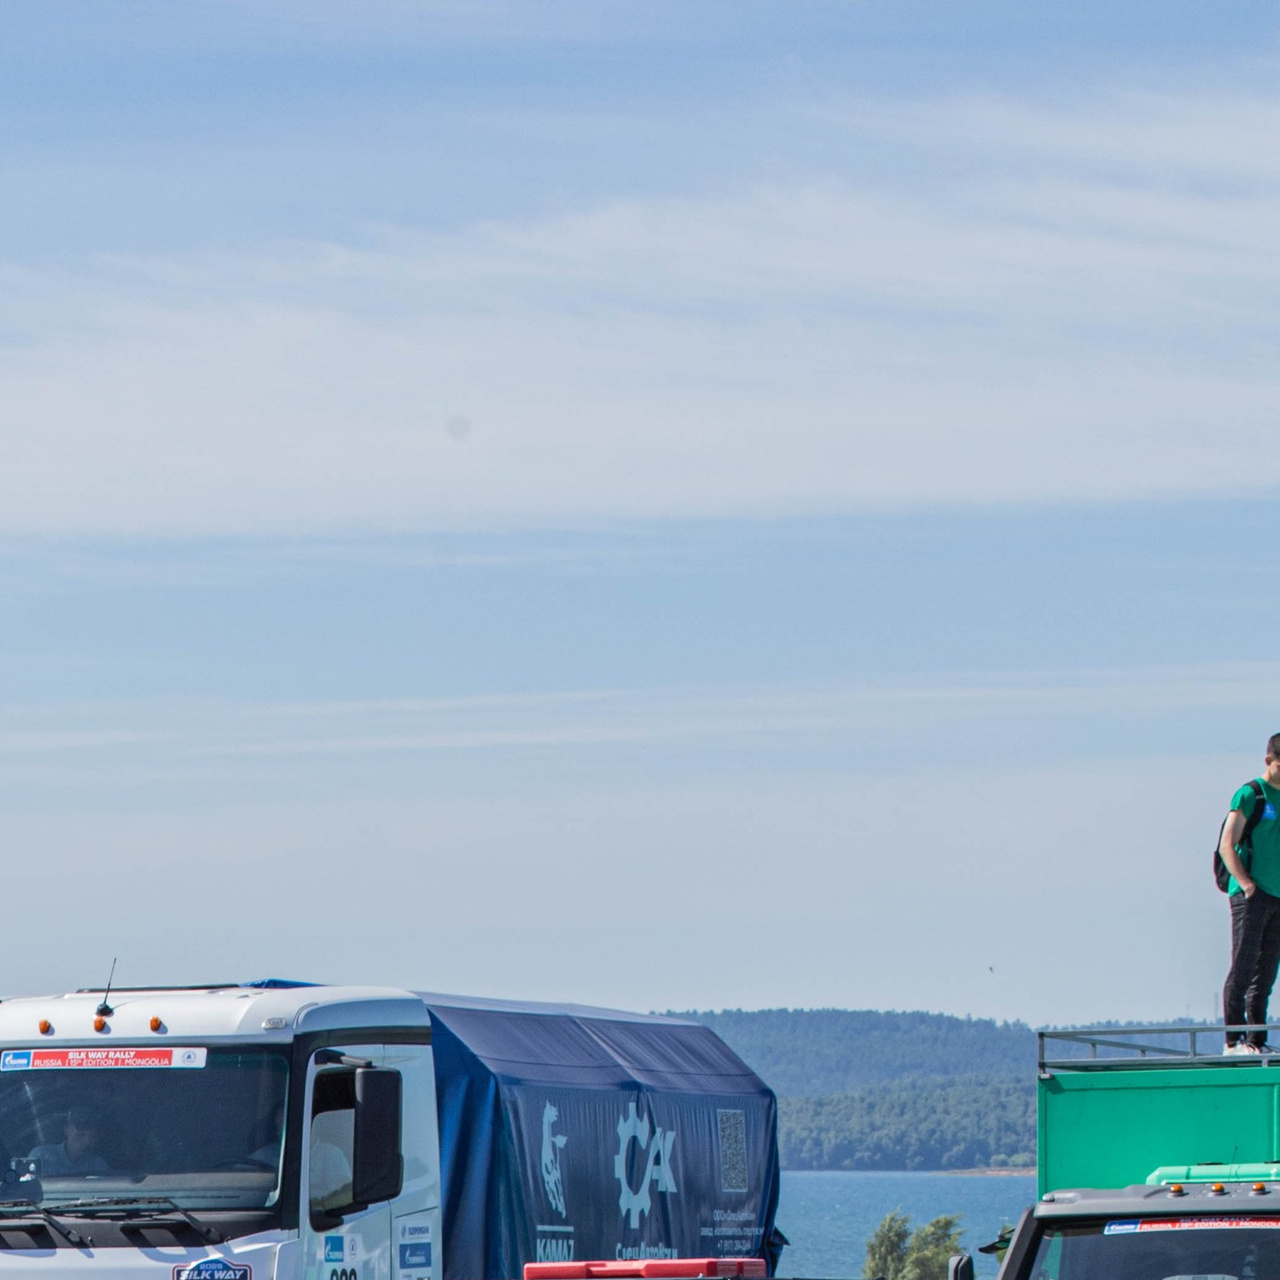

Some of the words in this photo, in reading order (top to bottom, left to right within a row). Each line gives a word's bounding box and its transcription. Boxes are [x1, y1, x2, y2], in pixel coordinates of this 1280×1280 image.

[68, 1051, 86, 1059] SILK
[88, 1051, 107, 1059] WAY
[108, 1051, 135, 1059] RALLY
[34, 1059, 62, 1067] RUSSIA
[82, 1058, 115, 1066] EDITION
[124, 1058, 169, 1066] MONGOLIA
[180, 1270, 212, 1280] SILK
[214, 1270, 244, 1280] WAY
